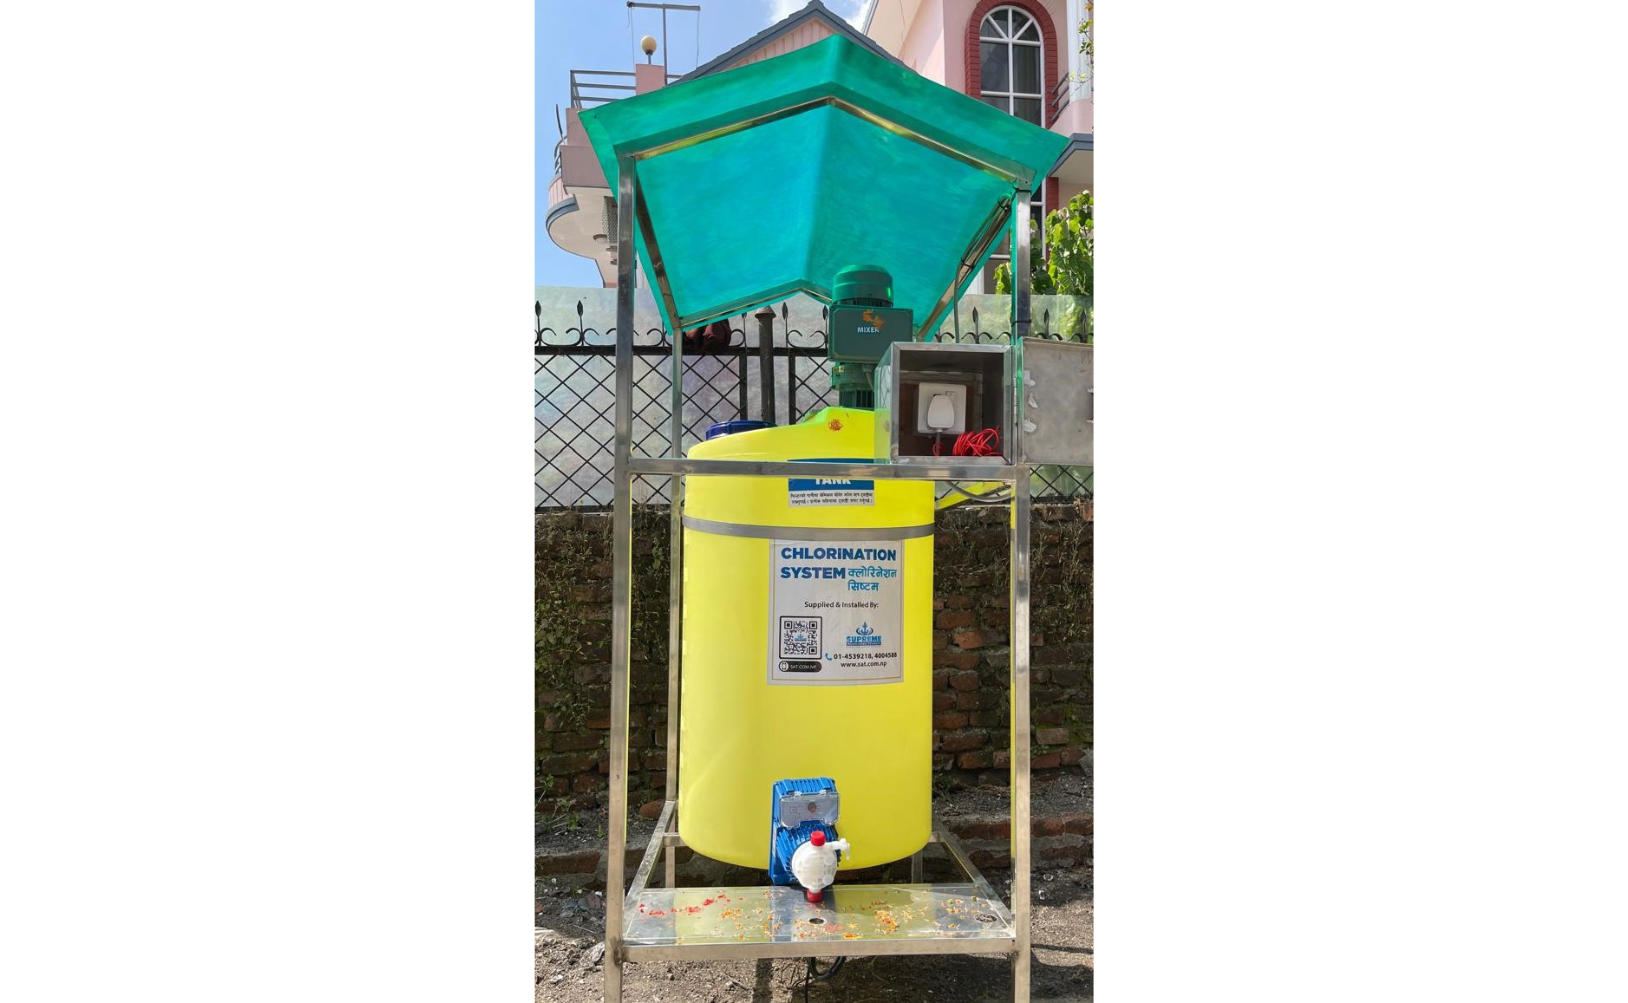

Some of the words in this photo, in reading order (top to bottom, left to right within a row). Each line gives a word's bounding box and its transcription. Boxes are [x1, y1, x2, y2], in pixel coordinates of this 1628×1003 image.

[781, 547, 897, 561] CHLORINATION
[780, 566, 846, 579] SYSTEM
[848, 565, 897, 579] क्लोरिनेशन
[847, 579, 880, 591] सिष्टम
[804, 601, 834, 609] Supplied
[846, 635, 882, 643] SUPREME
